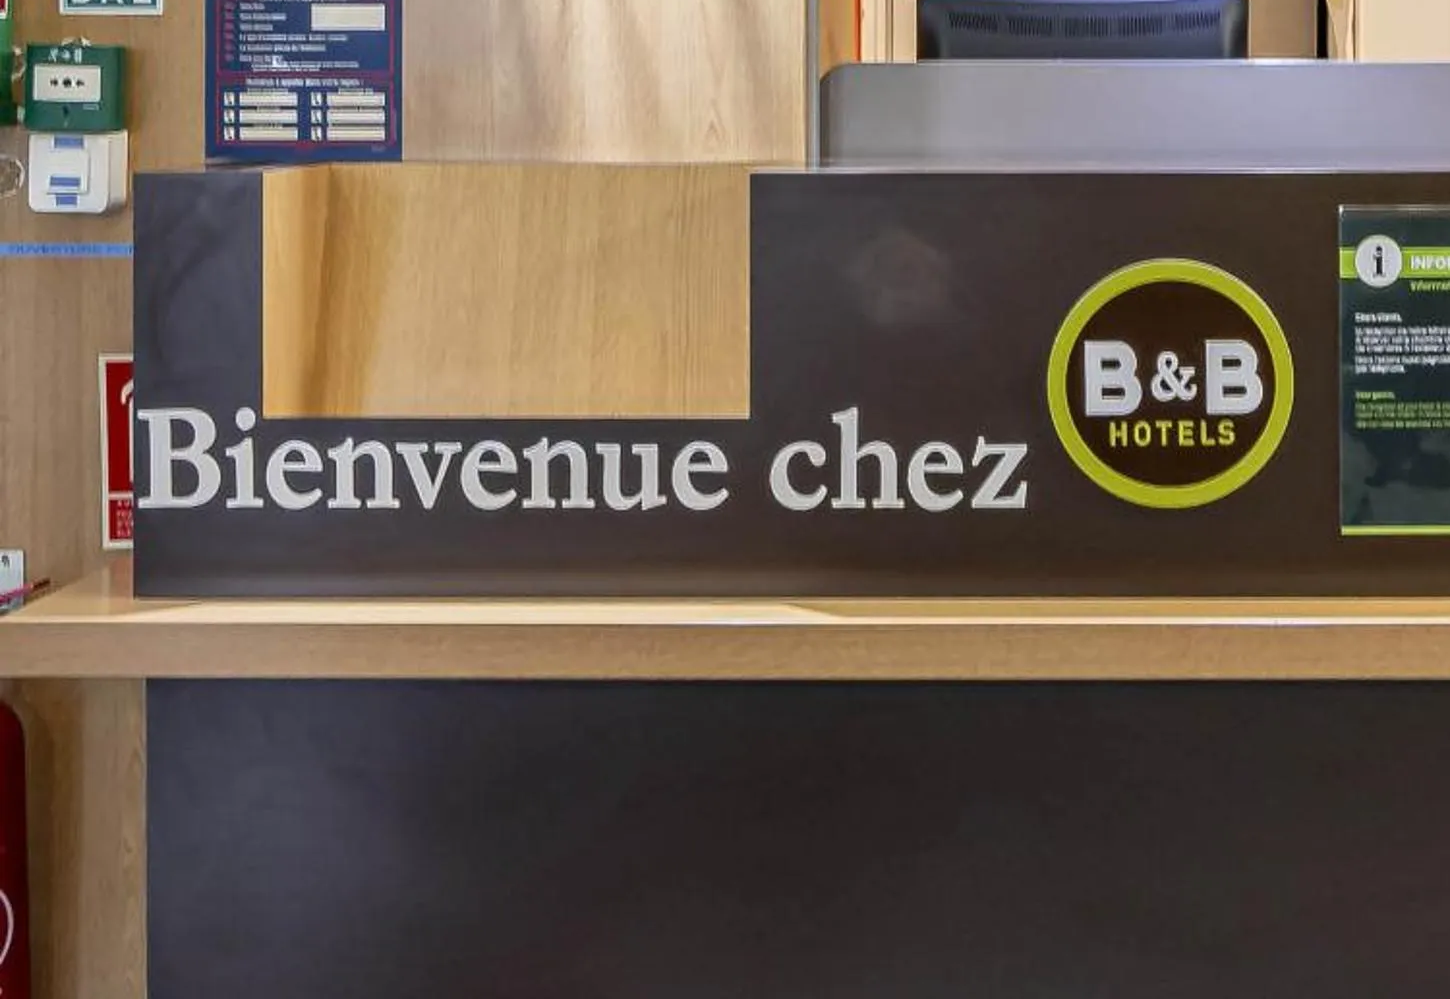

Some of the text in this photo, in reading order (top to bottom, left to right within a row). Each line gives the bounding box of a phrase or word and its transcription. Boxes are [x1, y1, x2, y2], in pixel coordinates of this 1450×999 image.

[1084, 339, 1263, 417] B&B
[137, 406, 1028, 512] Bienvenue chez
[1109, 418, 1237, 448] HOTELS
